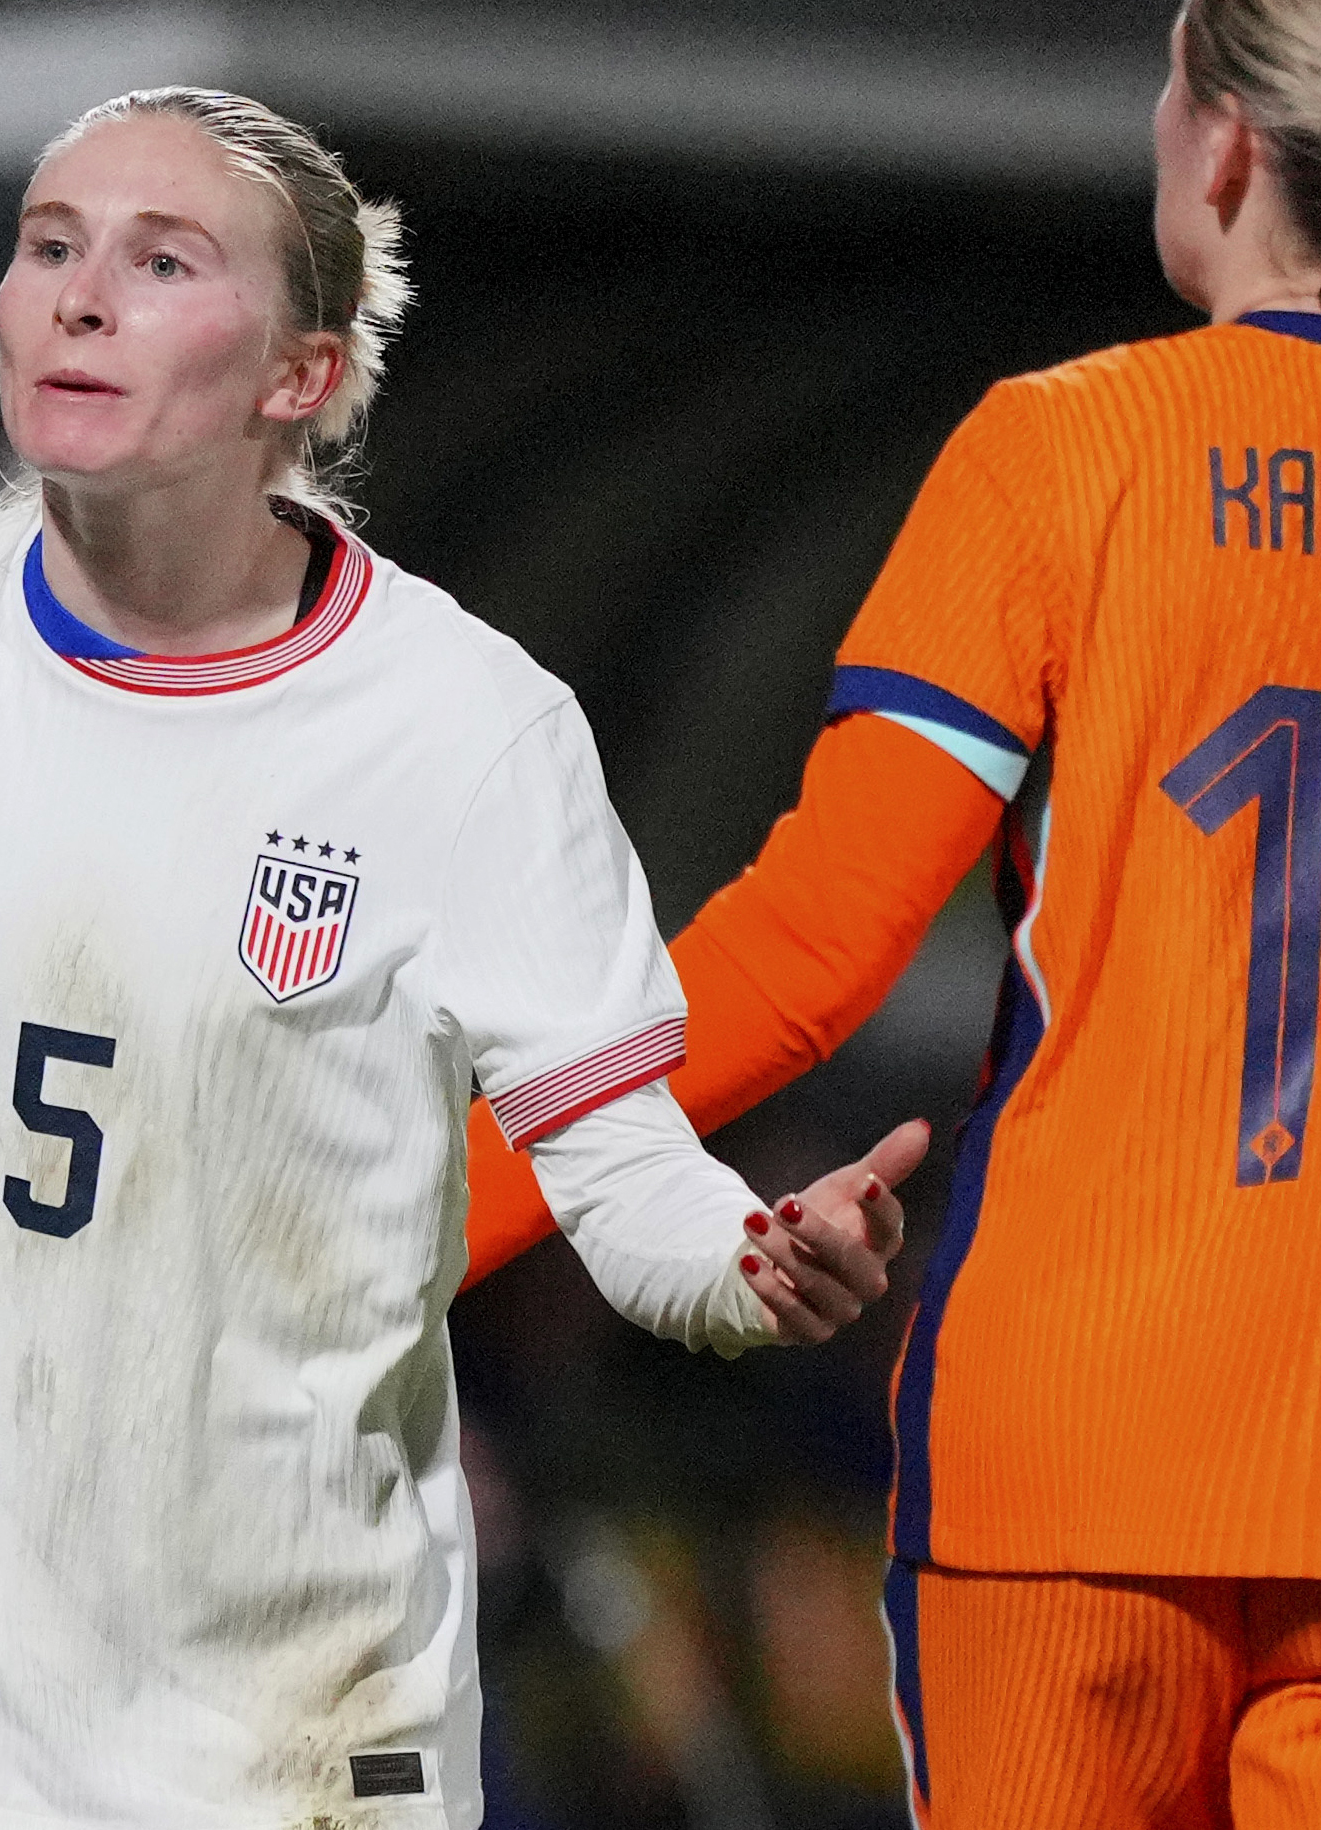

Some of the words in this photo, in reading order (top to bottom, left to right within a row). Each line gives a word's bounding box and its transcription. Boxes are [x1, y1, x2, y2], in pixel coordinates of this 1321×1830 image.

[1209, 446, 1315, 554] KA
[259, 865, 348, 923] USA
[1159, 684, 1321, 1188] 1
[2, 1021, 116, 1239] 5
